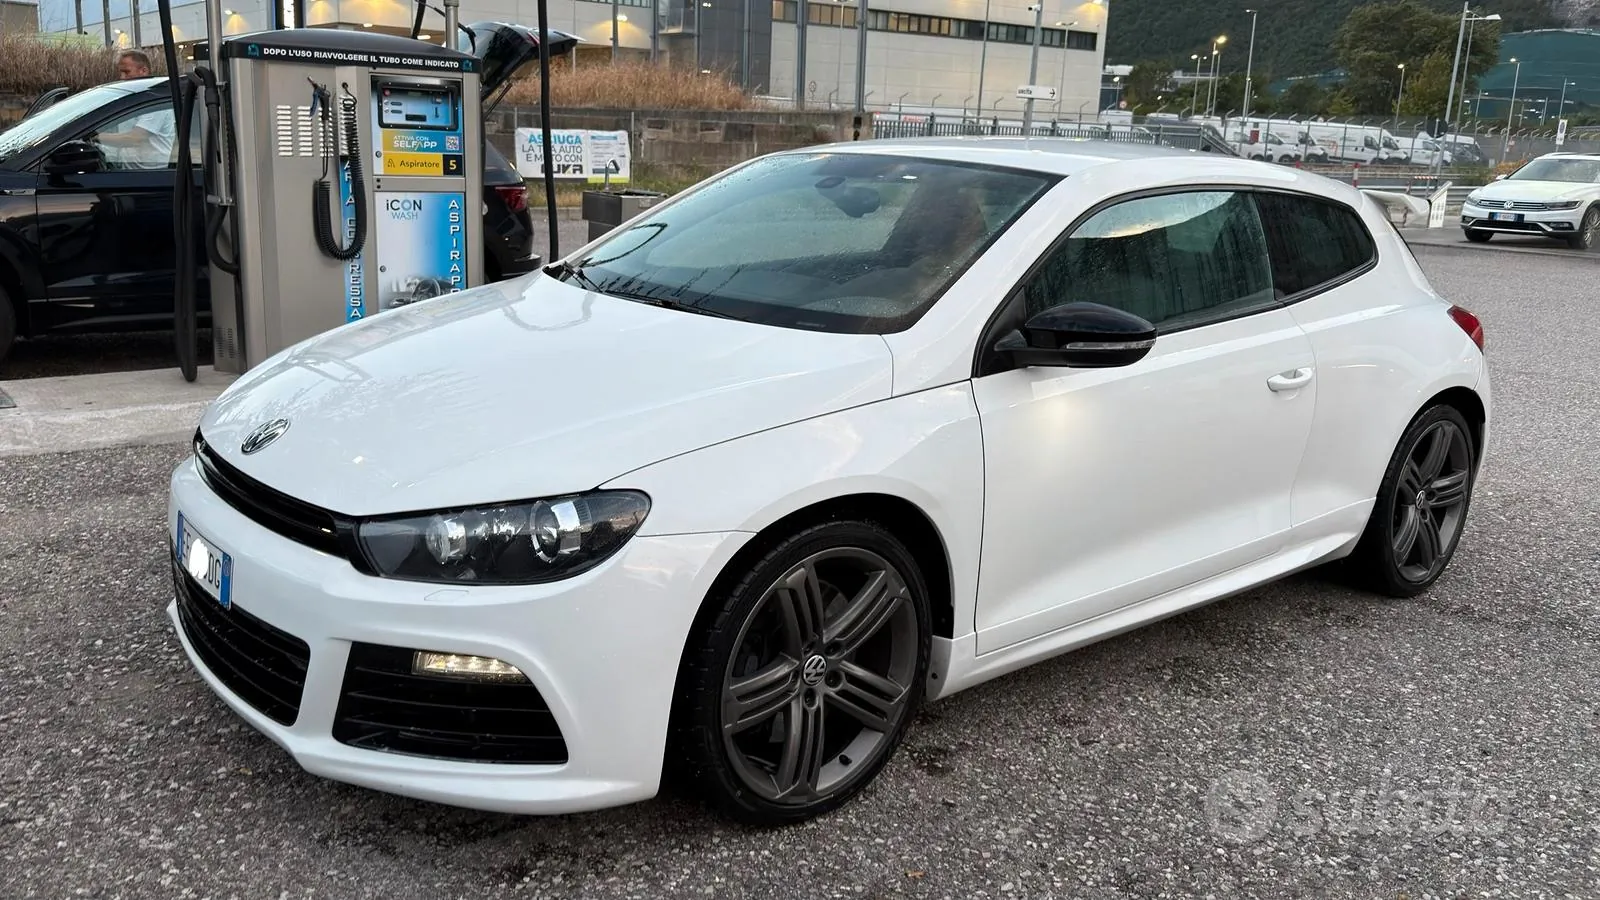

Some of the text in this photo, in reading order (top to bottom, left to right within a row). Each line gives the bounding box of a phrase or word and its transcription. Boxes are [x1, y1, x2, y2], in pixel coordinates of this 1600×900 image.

[263, 47, 459, 69] DOPO L'USO RIAVVOLGERE IL TUBO COME INDICATO
[528, 134, 582, 144] ASIUGA
[393, 141, 437, 150] SELFAPP
[522, 144, 583, 153] LA TA AUTO
[526, 154, 583, 162] E MTO CON
[400, 159, 440, 169] Aspiratore
[449, 160, 457, 170] 5
[391, 211, 419, 221] WASH
